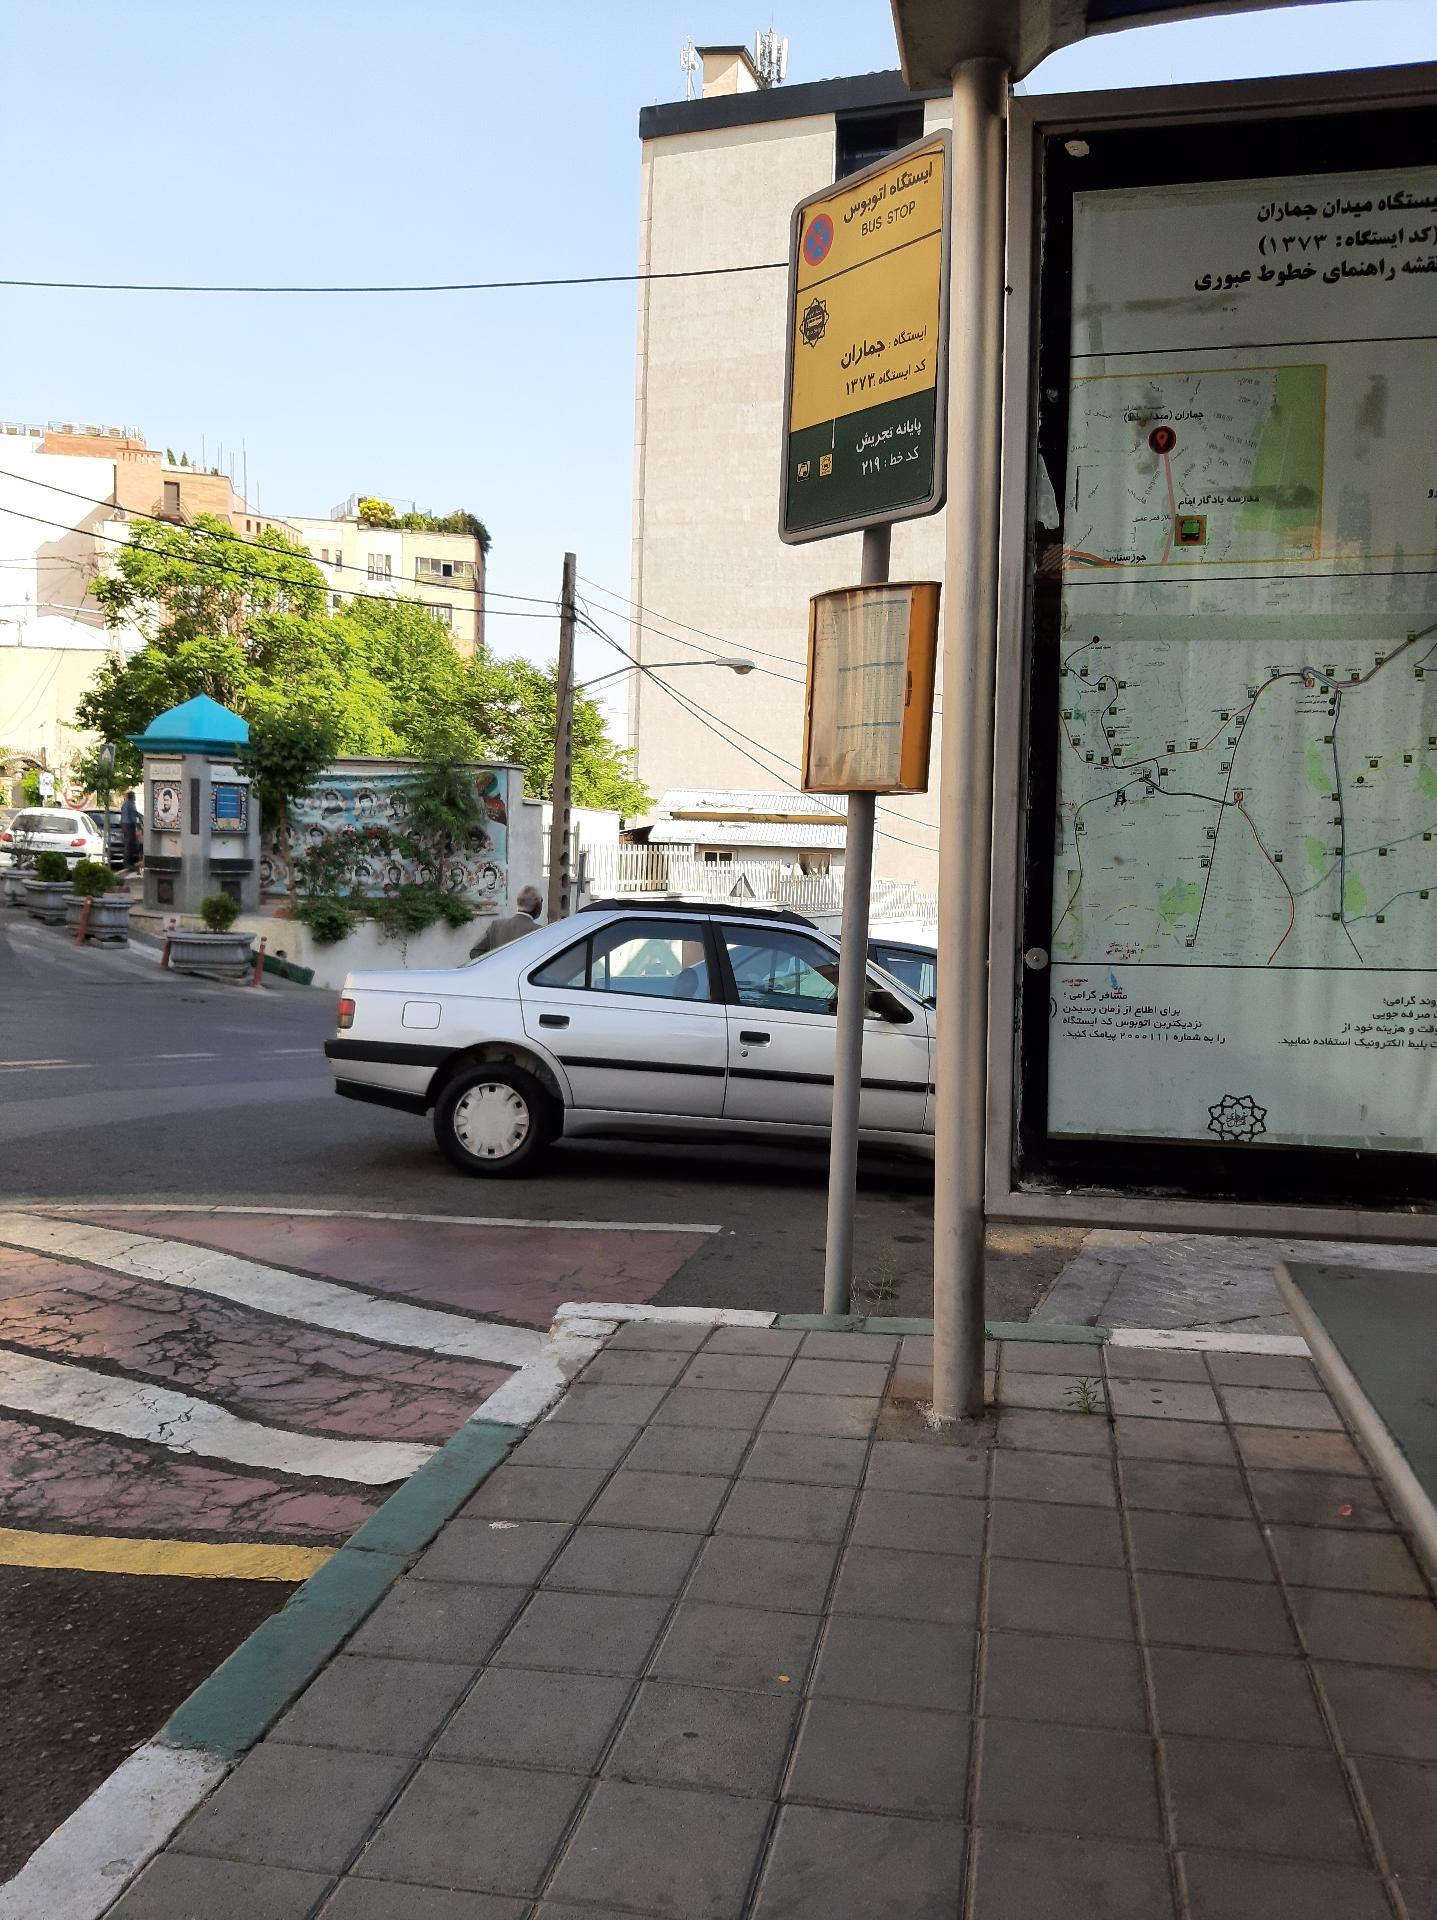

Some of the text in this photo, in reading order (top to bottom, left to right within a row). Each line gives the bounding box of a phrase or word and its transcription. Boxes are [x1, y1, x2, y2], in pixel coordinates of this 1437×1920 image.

[844, 161, 933, 223] ایستگاه اتوبوس
[1257, 201, 1318, 222] جماران
[1323, 198, 1373, 218] میدان
[862, 200, 916, 236] BUS STOP
[1257, 261, 1317, 287] خطوط
[1322, 258, 1396, 284] راهنمای
[1194, 269, 1252, 291] عبوری
[840, 340, 886, 369] جماران
[914, 358, 926, 373] کد
[846, 372, 874, 395] ۱۳۷۳
[1174, 410, 1204, 421] جماران
[856, 417, 922, 453] پایانه تجریش
[906, 446, 919, 462] کد
[862, 456, 880, 476] ۲۱۹
[1197, 494, 1224, 506] یادگار
[1098, 992, 1128, 1002] مسافر
[1419, 997, 1437, 1008] وند
[1062, 1004, 1181, 1018] برای اطلاع از زمان رسیدن
[1372, 1012, 1398, 1020] جویی
[1400, 1010, 1430, 1020] صرفه
[1062, 1015, 1202, 1030] نزدیکترین اتوبوس کد ایستگاه
[1341, 1022, 1351, 1034] از
[1354, 1023, 1373, 1034] خود
[1376, 1024, 1406, 1034] هزینه
[1408, 1027, 1415, 1036] و
[1090, 1030, 1117, 1041] پیامک
[1173, 1032, 1201, 1044] شماره
[1204, 1034, 1214, 1044] به
[1216, 1032, 1226, 1044] را
[1313, 1038, 1351, 1046] استفاده
[1354, 1039, 1404, 1050] الکترونیک
